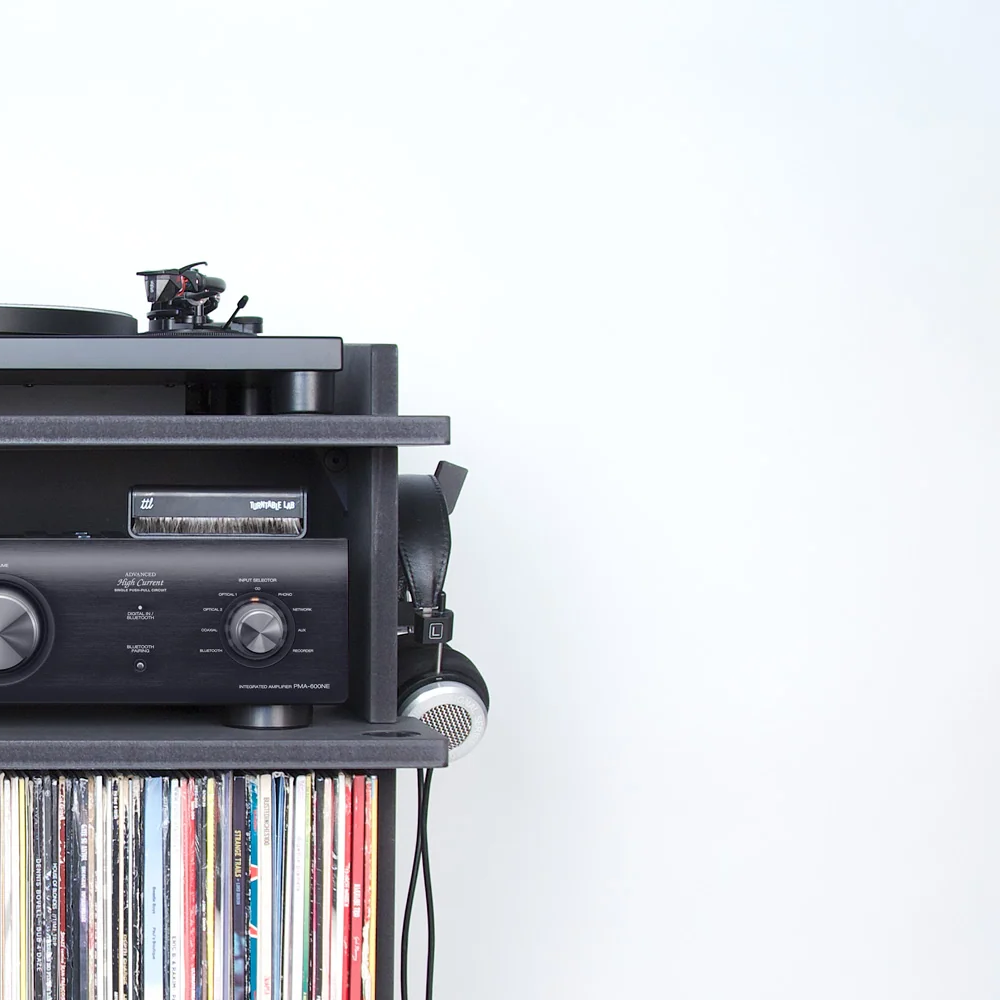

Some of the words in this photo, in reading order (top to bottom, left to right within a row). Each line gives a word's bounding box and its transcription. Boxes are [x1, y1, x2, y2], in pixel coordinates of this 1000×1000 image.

[250, 500, 281, 510] TURNTABLE
[283, 500, 295, 510] LAB
[117, 577, 136, 588] High
[136, 578, 164, 587] Current
[431, 626, 440, 636] L
[234, 829, 242, 858] STRANGE
[234, 858, 242, 878] TRAILS
[52, 879, 58, 888] OF
